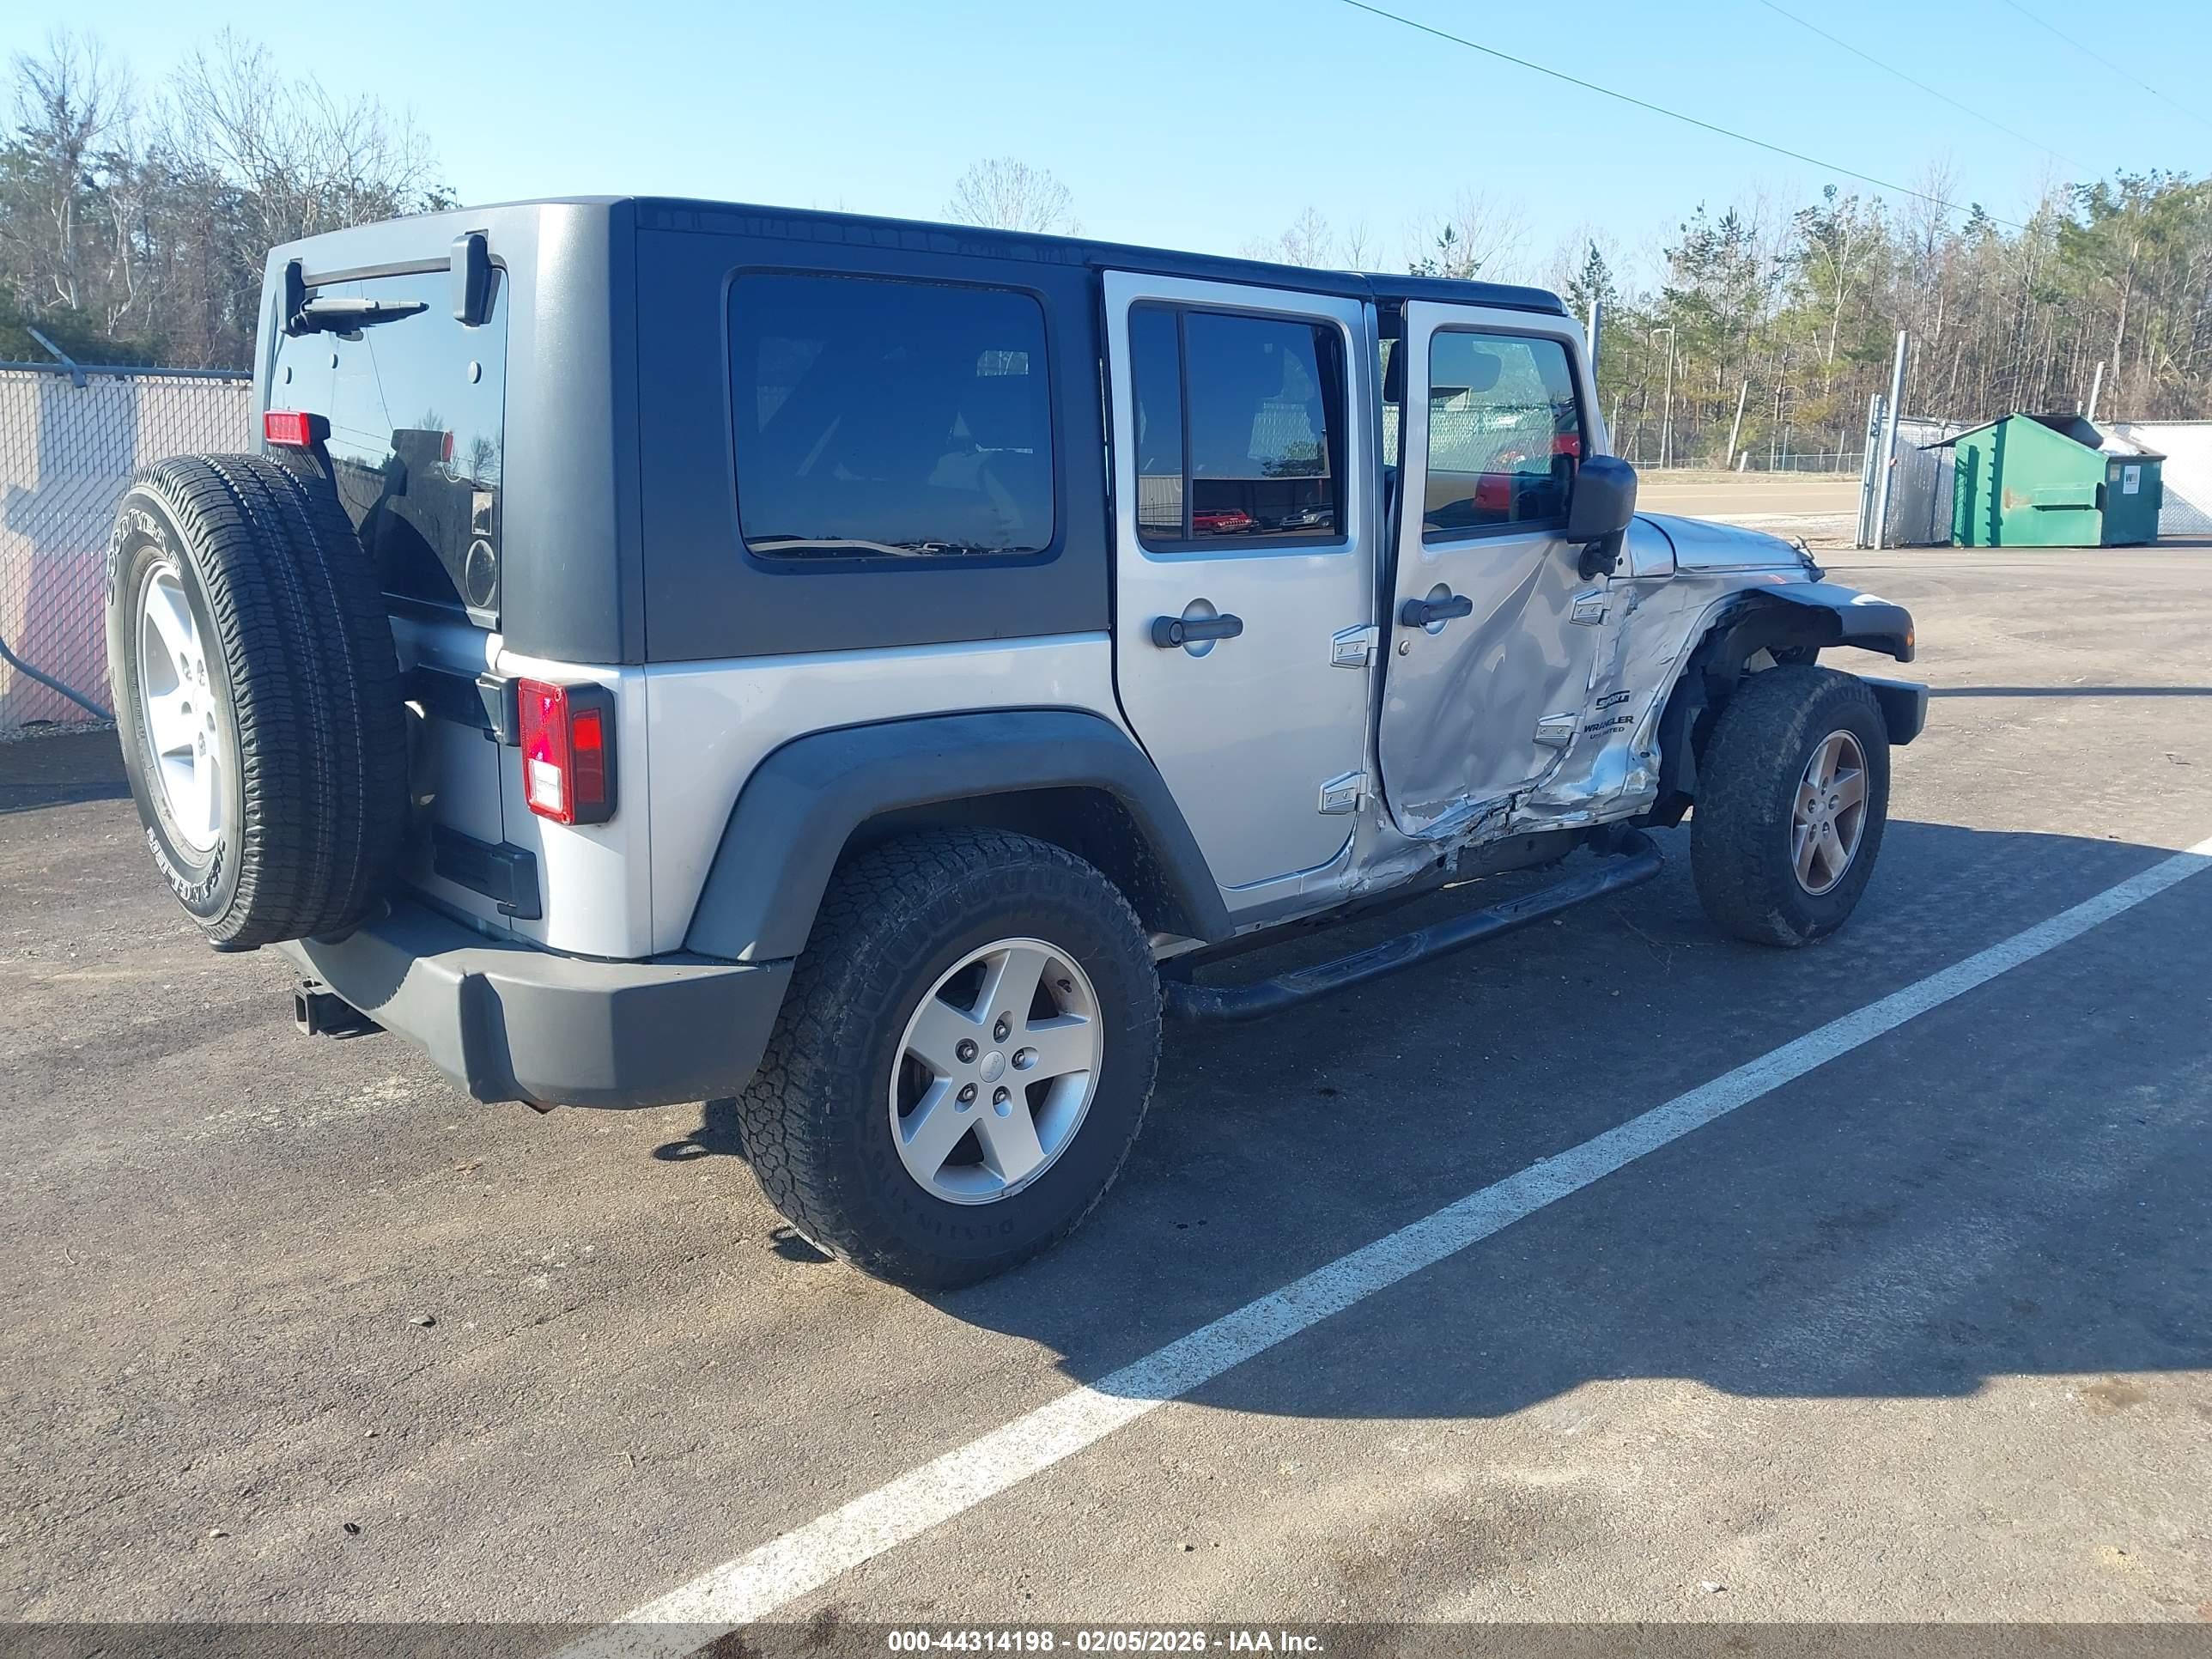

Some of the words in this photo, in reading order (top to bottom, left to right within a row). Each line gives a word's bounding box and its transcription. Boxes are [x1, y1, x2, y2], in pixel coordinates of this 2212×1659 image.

[106, 508, 183, 605] GOODYEAR
[1597, 692, 1629, 708] SPORT
[1583, 715, 1634, 733] WRANGLER
